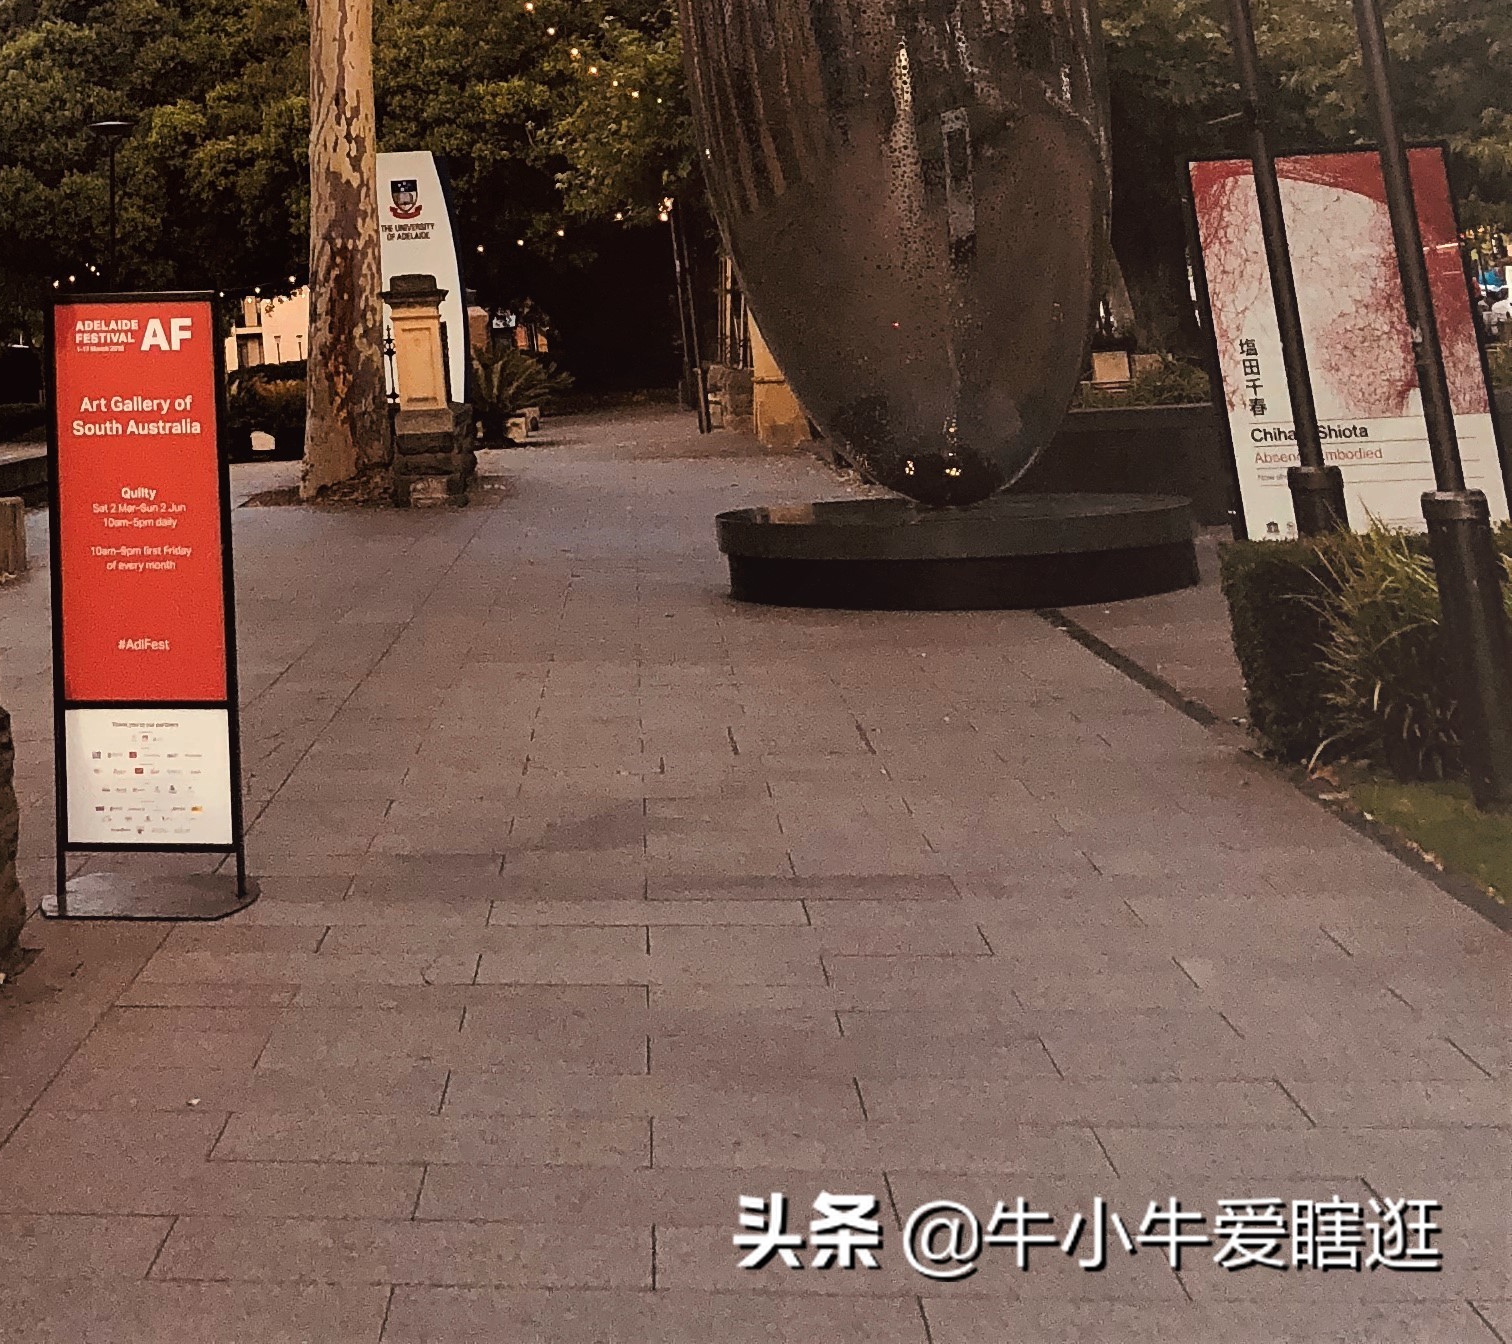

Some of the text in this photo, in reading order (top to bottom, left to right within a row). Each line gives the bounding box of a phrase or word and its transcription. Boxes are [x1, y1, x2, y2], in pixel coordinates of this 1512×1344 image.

[381, 223, 434, 232] THE UNIVERSITY
[387, 232, 430, 241] OF ADELAIDE
[76, 320, 138, 331] ADELAIDE
[76, 332, 135, 343] FESTIVAL
[141, 318, 192, 351] AF
[1239, 338, 1267, 416] 塩田千春
[80, 395, 192, 414] Art Gallery of
[72, 418, 201, 435] South Australia
[1251, 424, 1368, 442] Chiha Shiota
[1326, 448, 1383, 461] mbodied
[121, 487, 156, 500] Quilty
[92, 503, 108, 513] Sat
[110, 503, 117, 513] 2
[160, 502, 167, 512] 2
[168, 503, 186, 512] Jun
[156, 517, 177, 528] daily
[144, 545, 161, 555] first
[163, 545, 192, 557] Friday
[107, 560, 176, 571] of every month
[118, 638, 170, 651] #AdlFest
